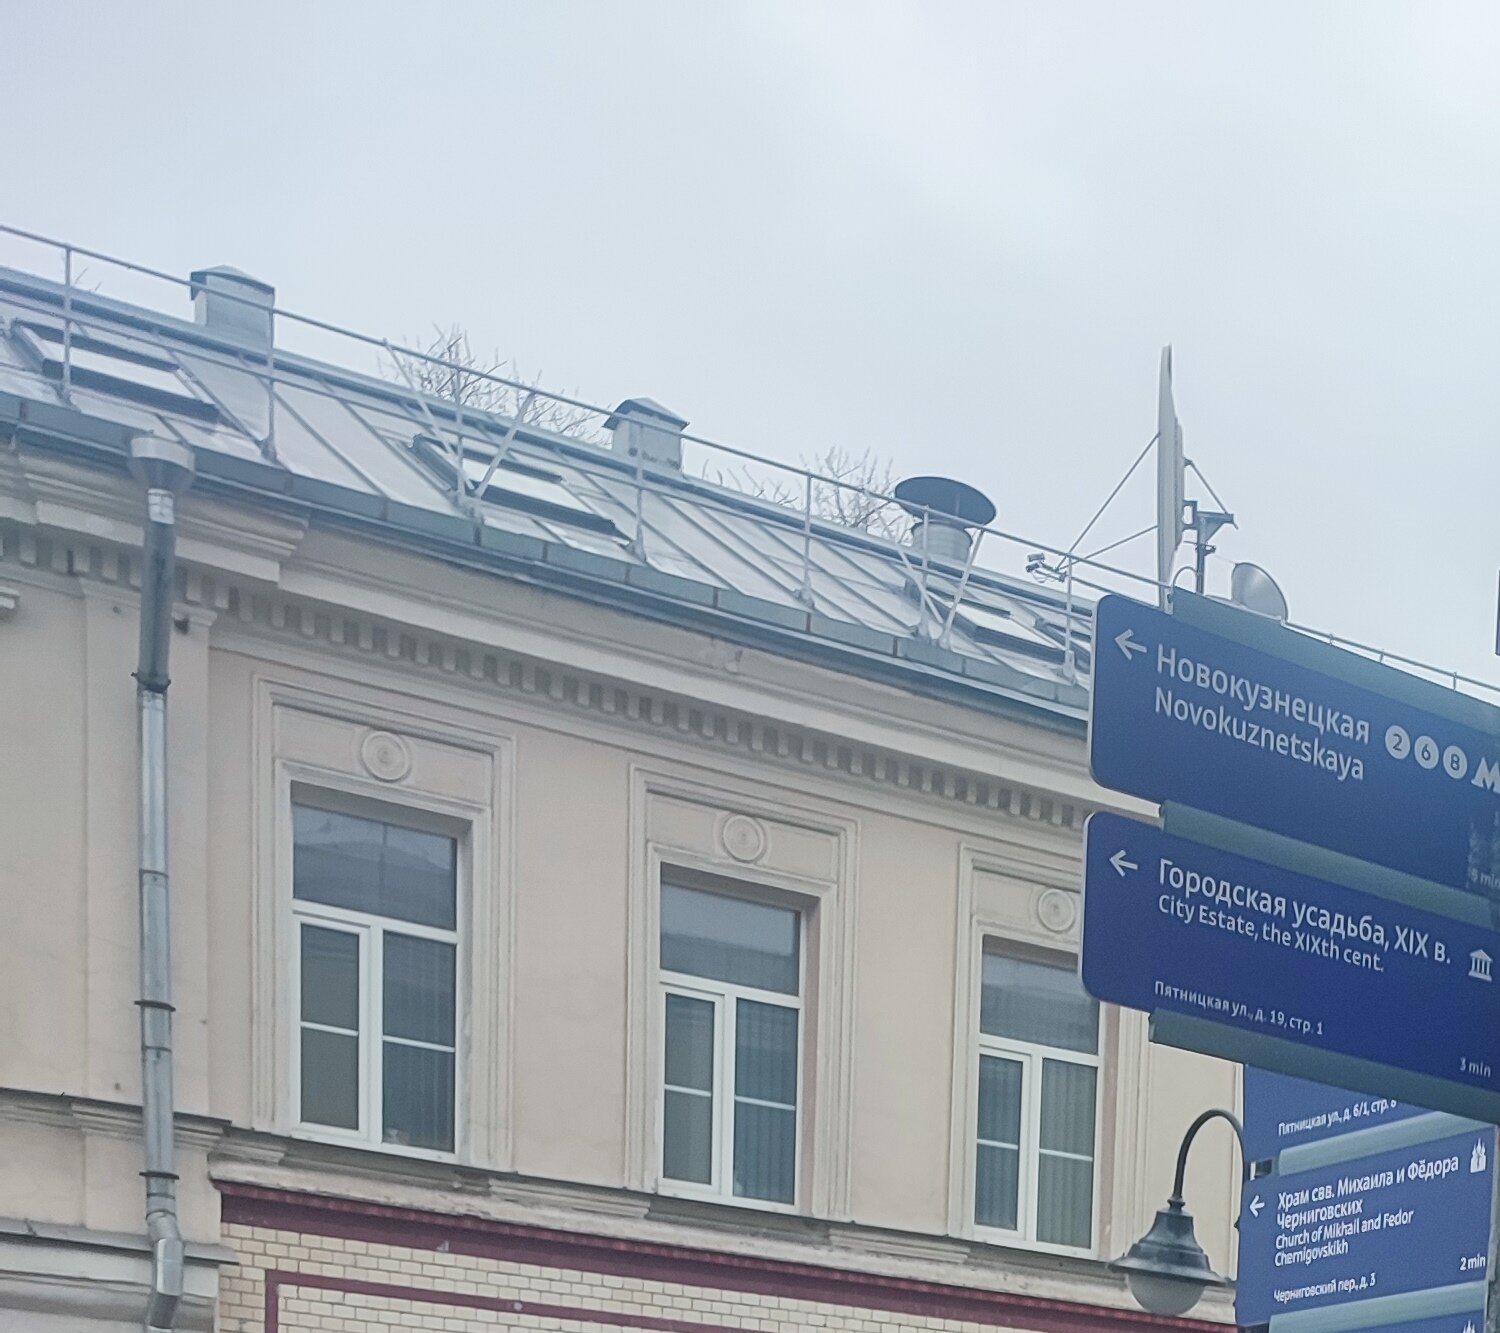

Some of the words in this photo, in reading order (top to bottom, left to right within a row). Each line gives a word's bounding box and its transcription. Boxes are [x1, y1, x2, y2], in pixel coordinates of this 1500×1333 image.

[1157, 643, 1370, 745] Новокузнецкая
[1155, 687, 1364, 781] Novokuznetskaya
[1159, 895, 1194, 923] City
[1199, 905, 1258, 941] Estate,
[1262, 923, 1290, 946] the
[1294, 932, 1339, 958] XIXth
[1342, 949, 1384, 971] cent.
[1160, 859, 1285, 918] Городская
[1292, 901, 1389, 950] усадьба,
[1394, 926, 1427, 957] XIX
[1434, 942, 1450, 964] в.
[1154, 981, 1229, 1011] Пятницкая
[1254, 1009, 1266, 1022] д.
[1270, 1010, 1288, 1028] 19,
[1289, 1017, 1313, 1034] стр.
[1316, 1022, 1322, 1034] 1
[1460, 1058, 1465, 1070] 3
[1468, 1062, 1490, 1077] min
[1277, 1190, 1309, 1212] Храм
[1311, 1185, 1334, 1201] свв.
[1337, 1172, 1393, 1196] Михаила
[1396, 1168, 1404, 1183] и
[1407, 1157, 1458, 1181] Фёдора
[1275, 1230, 1309, 1250] Church
[1311, 1226, 1322, 1242] of
[1323, 1218, 1359, 1239] Mikhail
[1361, 1214, 1380, 1232] and
[1383, 1209, 1413, 1228] Fedor
[1277, 1199, 1363, 1231] Черниговских
[1460, 1257, 1466, 1270] 2
[1467, 1254, 1486, 1269] min
